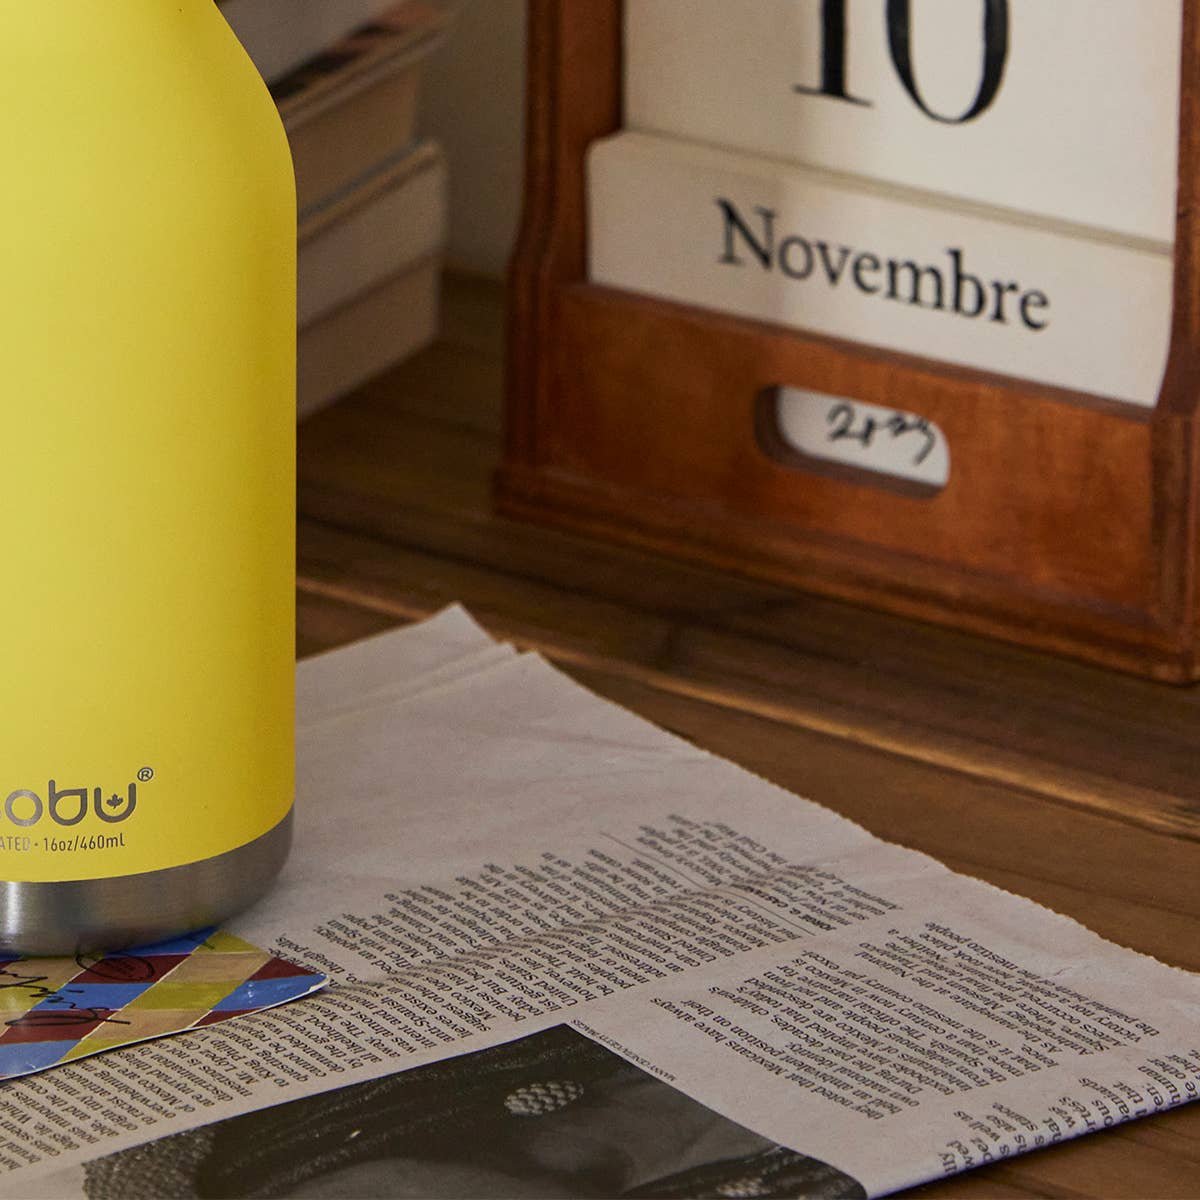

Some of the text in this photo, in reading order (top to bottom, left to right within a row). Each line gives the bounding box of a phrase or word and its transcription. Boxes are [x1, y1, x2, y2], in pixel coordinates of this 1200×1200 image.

[714, 197, 1051, 333] Novembre
[43, 832, 126, 853] 16oz/460ml
[371, 929, 424, 959] Mexican
[421, 976, 497, 1021] Mexico does
[481, 979, 509, 996] But
[380, 996, 456, 1043] anti-Spanish
[441, 1002, 492, 1032] suggest
[649, 997, 697, 1023] always
[680, 999, 715, 1017] their
[779, 1006, 811, 1024] that
[812, 1008, 838, 1023] are
[303, 1014, 367, 1055] likelihood,
[339, 1019, 366, 1038] The
[693, 1021, 728, 1044] have
[770, 1014, 827, 1048] decades,
[804, 1021, 859, 1050] implied
[835, 1022, 885, 1048] Mexico
[209, 1039, 248, 1062] Philip
[278, 1034, 346, 1073] demanded
[729, 1025, 786, 1058] position
[821, 1046, 858, 1062] past
[198, 1049, 238, 1073] López
[724, 1040, 789, 1076] Mexicans
[856, 1047, 892, 1066] have
[1146, 1058, 1187, 1080] other
[57, 1067, 112, 1097] attitudes
[149, 1053, 234, 1102] discrimination
[243, 1059, 276, 1080] King
[779, 1054, 854, 1091] ambivalent
[784, 1072, 816, 1089] that
[873, 1068, 924, 1095] During
[137, 1079, 183, 1106] Mexico
[810, 1085, 854, 1107] noted
[1112, 1081, 1144, 1104] that
[106, 1095, 145, 1119] racist
[985, 1114, 1017, 1132] also
